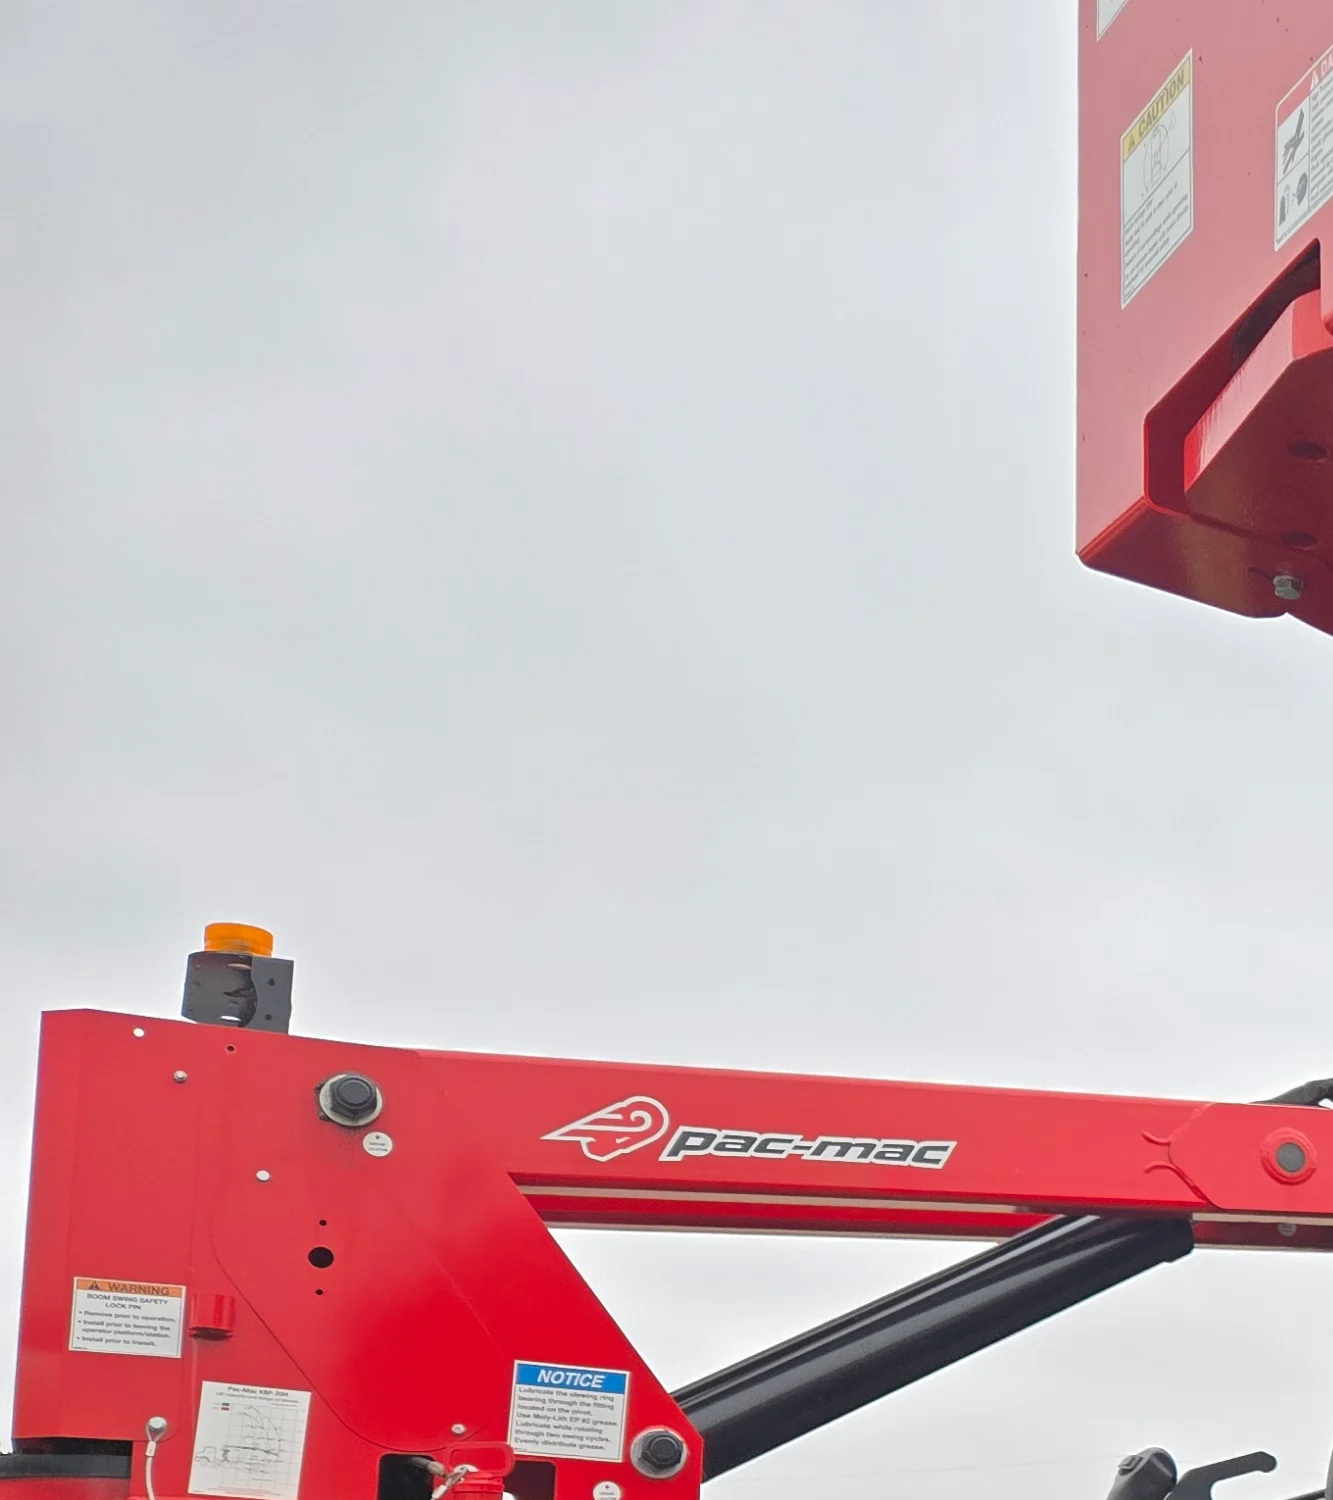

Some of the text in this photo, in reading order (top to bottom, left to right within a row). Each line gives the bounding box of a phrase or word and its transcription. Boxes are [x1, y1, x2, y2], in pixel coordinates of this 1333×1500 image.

[1137, 68, 1186, 138] CAUTION
[659, 1127, 956, 1168] pac-mac
[108, 1282, 169, 1296] WARNING
[133, 1323, 157, 1331] leaving
[537, 1369, 606, 1388] NOTICE
[228, 1386, 257, 1394] Pac-Mac
[519, 1387, 554, 1396] Lubricate
[600, 1394, 614, 1402] ring
[518, 1395, 546, 1404] bearing
[548, 1398, 580, 1407] through
[593, 1402, 614, 1410] fitting
[533, 1413, 567, 1422] Moly-Lith
[516, 1421, 551, 1429] Lubricate
[574, 1425, 602, 1434] rotating
[515, 1429, 544, 1437] through
[585, 1435, 611, 1443] cycles.
[515, 1437, 539, 1445] Evenly
[541, 1440, 576, 1448] distribute
